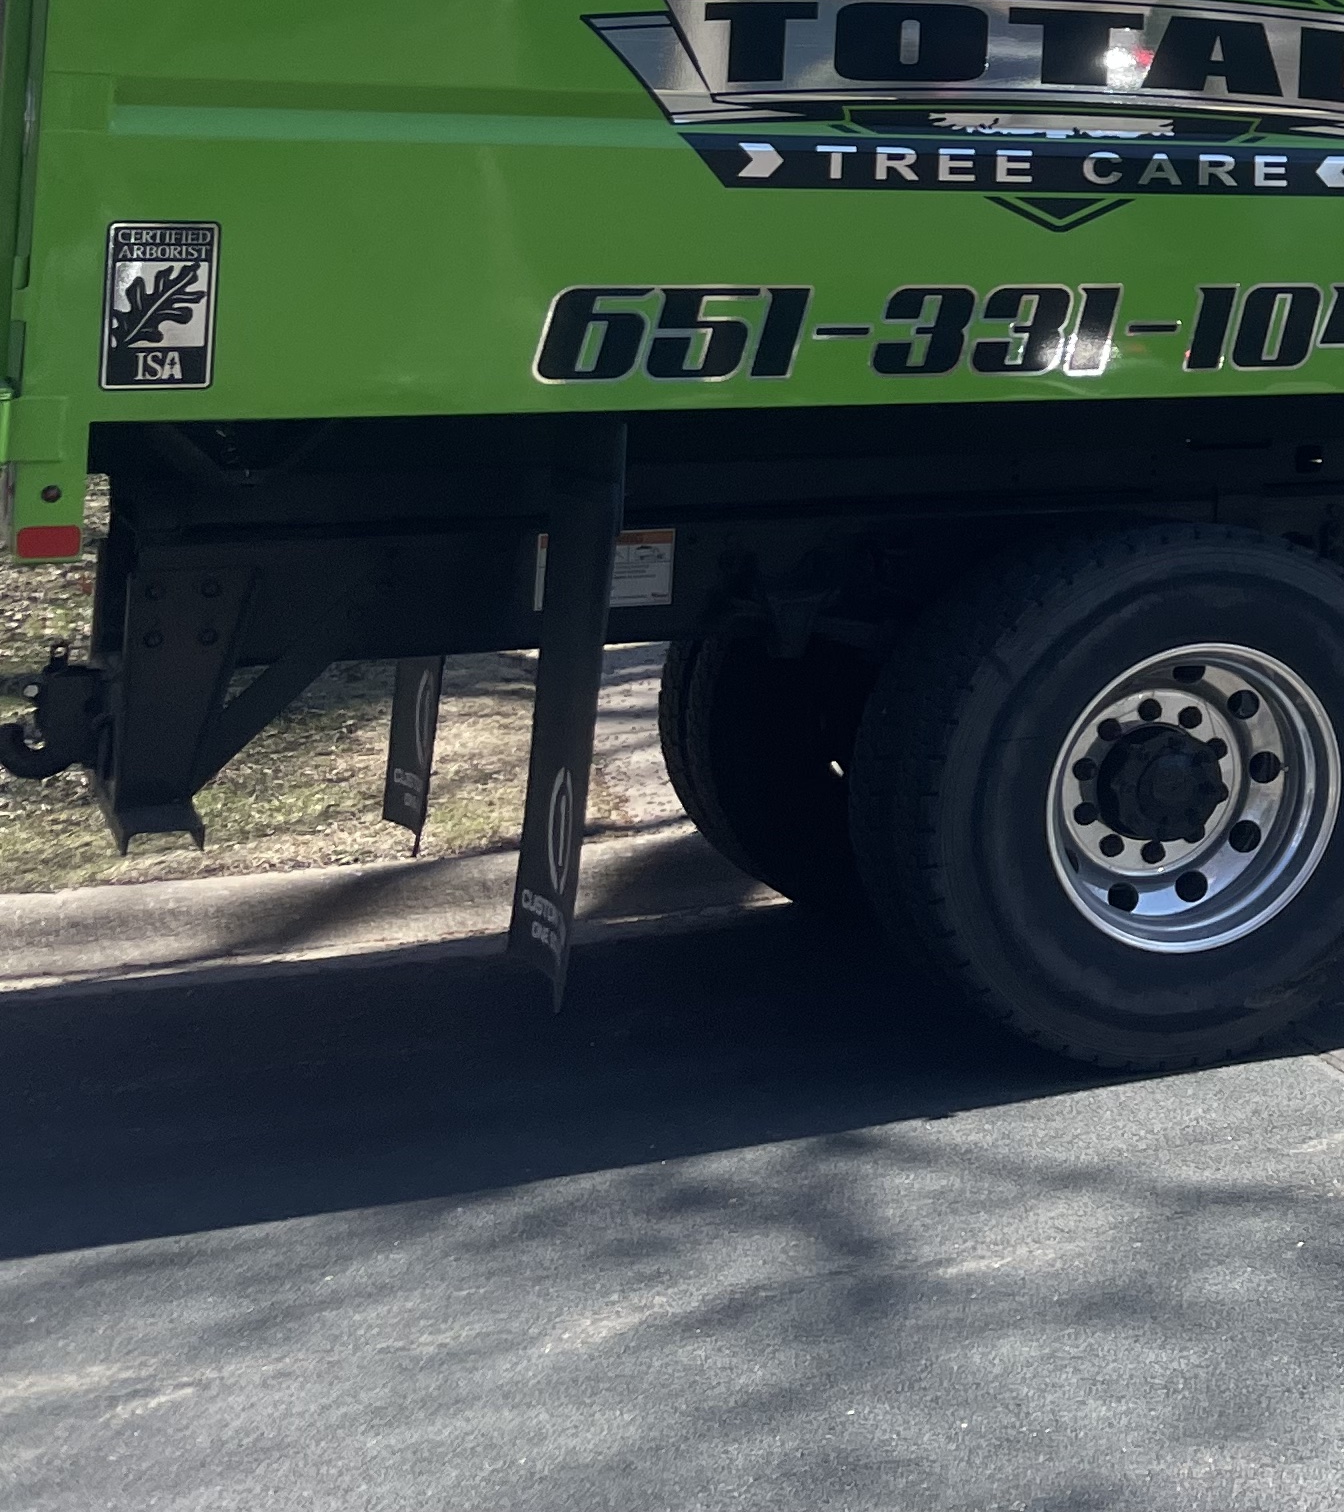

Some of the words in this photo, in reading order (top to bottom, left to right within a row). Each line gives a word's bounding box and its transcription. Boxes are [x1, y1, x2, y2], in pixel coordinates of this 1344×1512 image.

[815, 145, 1034, 183] TREE
[1082, 151, 1289, 188] CARE
[118, 229, 211, 244] CERTIFIED
[118, 245, 210, 259] ARBORIST
[134, 351, 183, 381] ISA
